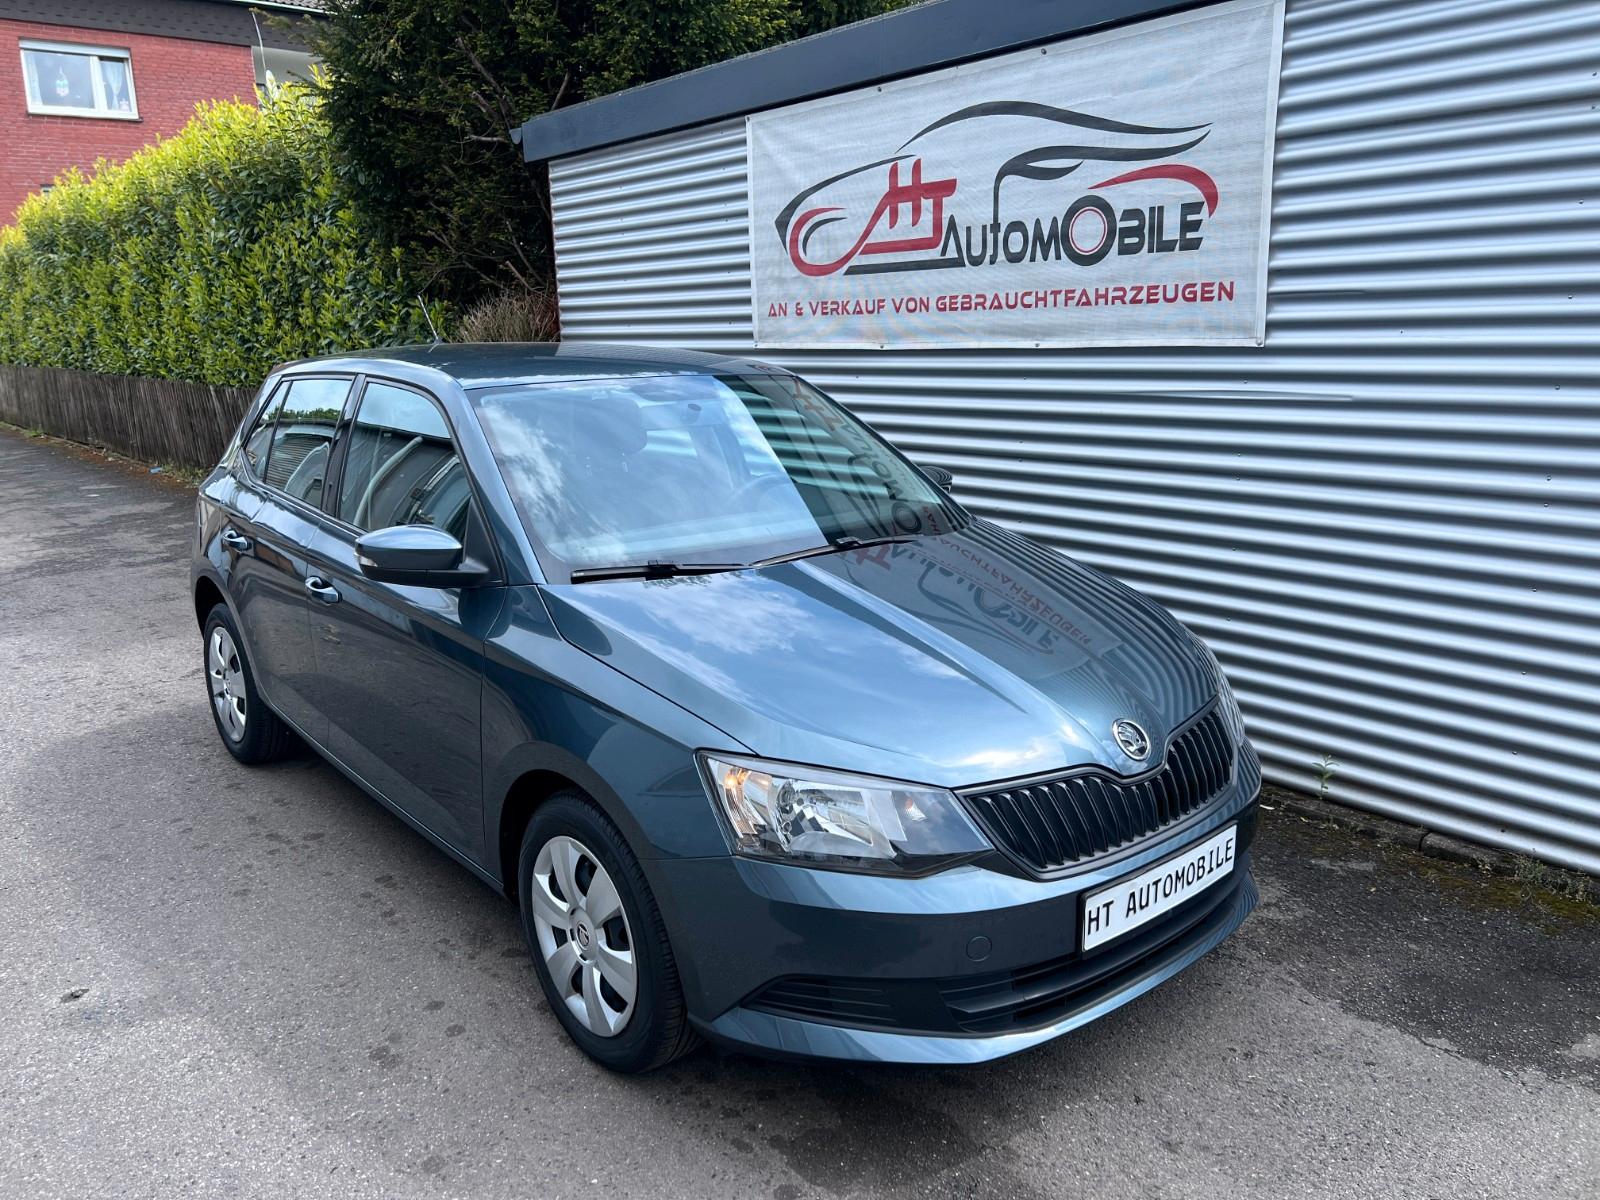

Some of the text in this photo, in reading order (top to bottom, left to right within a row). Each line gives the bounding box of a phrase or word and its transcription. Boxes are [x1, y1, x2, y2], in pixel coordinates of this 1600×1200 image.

[767, 280, 1235, 317] AN & VERKAUF VON GEBRAUCHTFAHRZEUGEN
[1087, 837, 1234, 935] HT AUTOMOBILE
